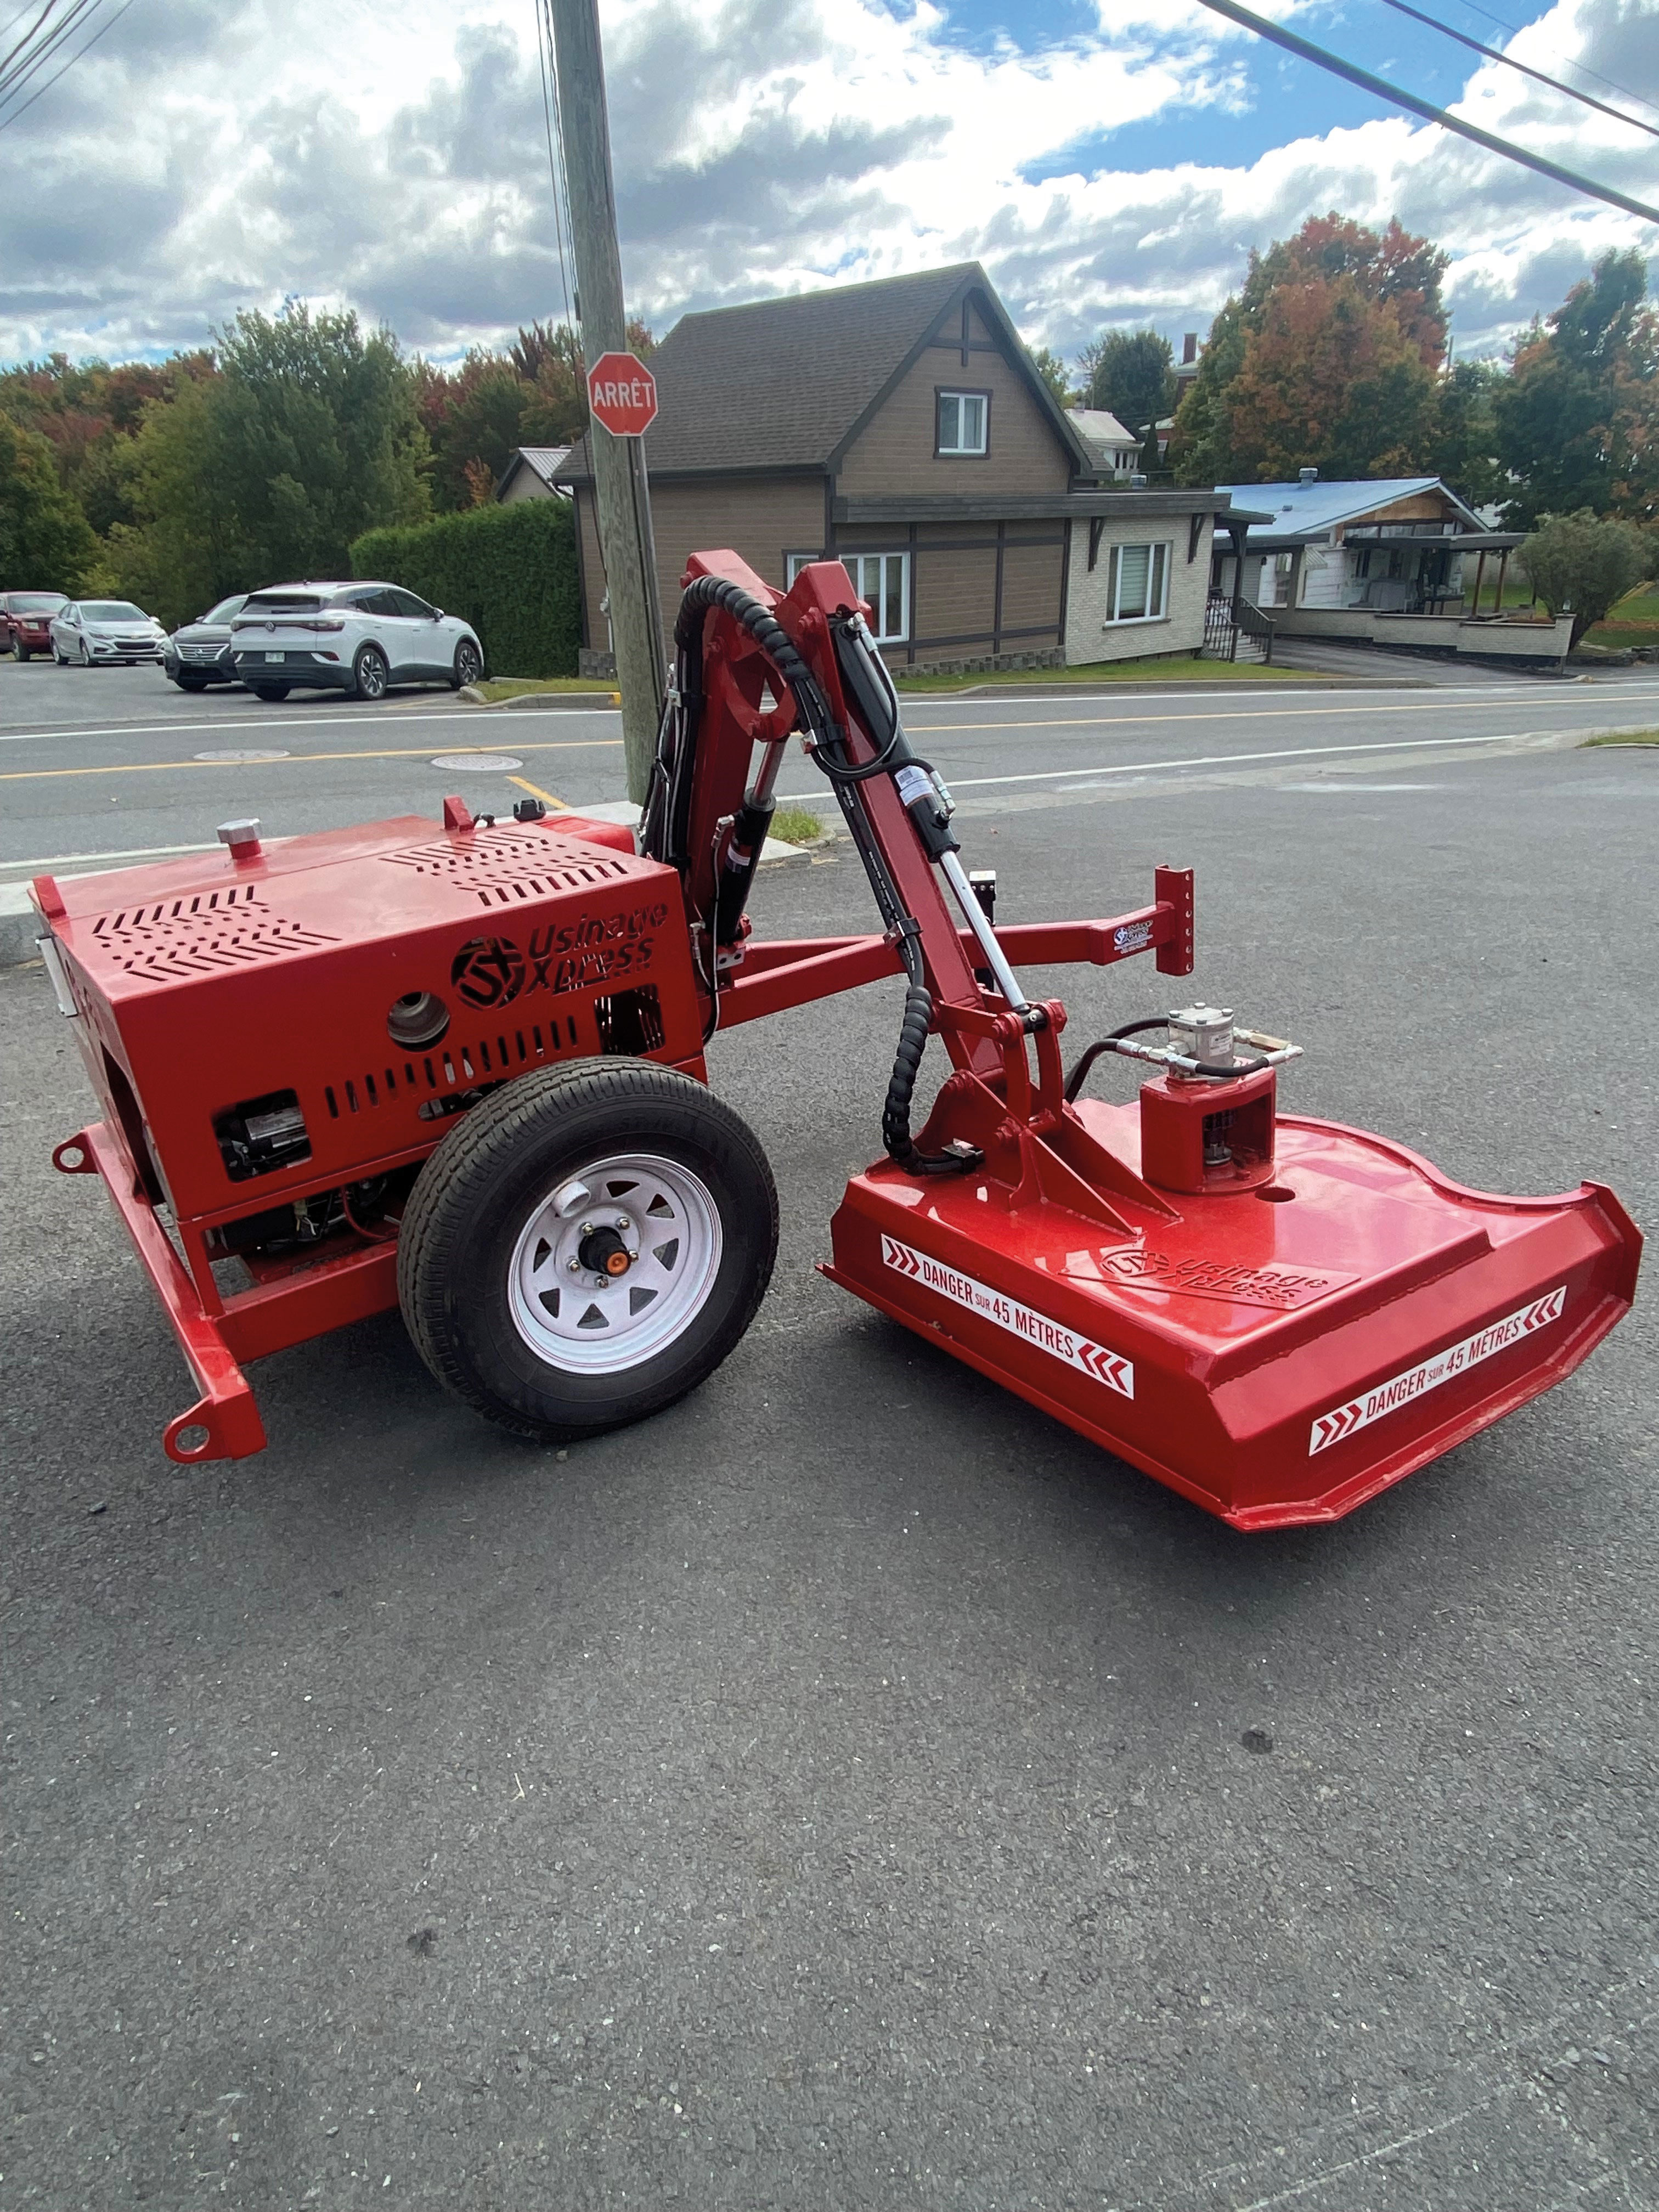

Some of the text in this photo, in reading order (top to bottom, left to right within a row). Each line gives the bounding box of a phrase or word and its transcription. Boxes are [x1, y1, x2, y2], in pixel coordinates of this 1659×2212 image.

[594, 377, 652, 408] ARRÊT
[528, 904, 668, 961] Usinage
[1174, 1259, 1328, 1288] Usinage
[923, 1260, 973, 1305] DANGER
[993, 1298, 1009, 1323] 45
[1015, 1307, 1074, 1358] MÈTRES
[1366, 1368, 1426, 1419] DANGER
[1447, 1347, 1465, 1373] 45
[1468, 1316, 1521, 1363] MÈTRES
